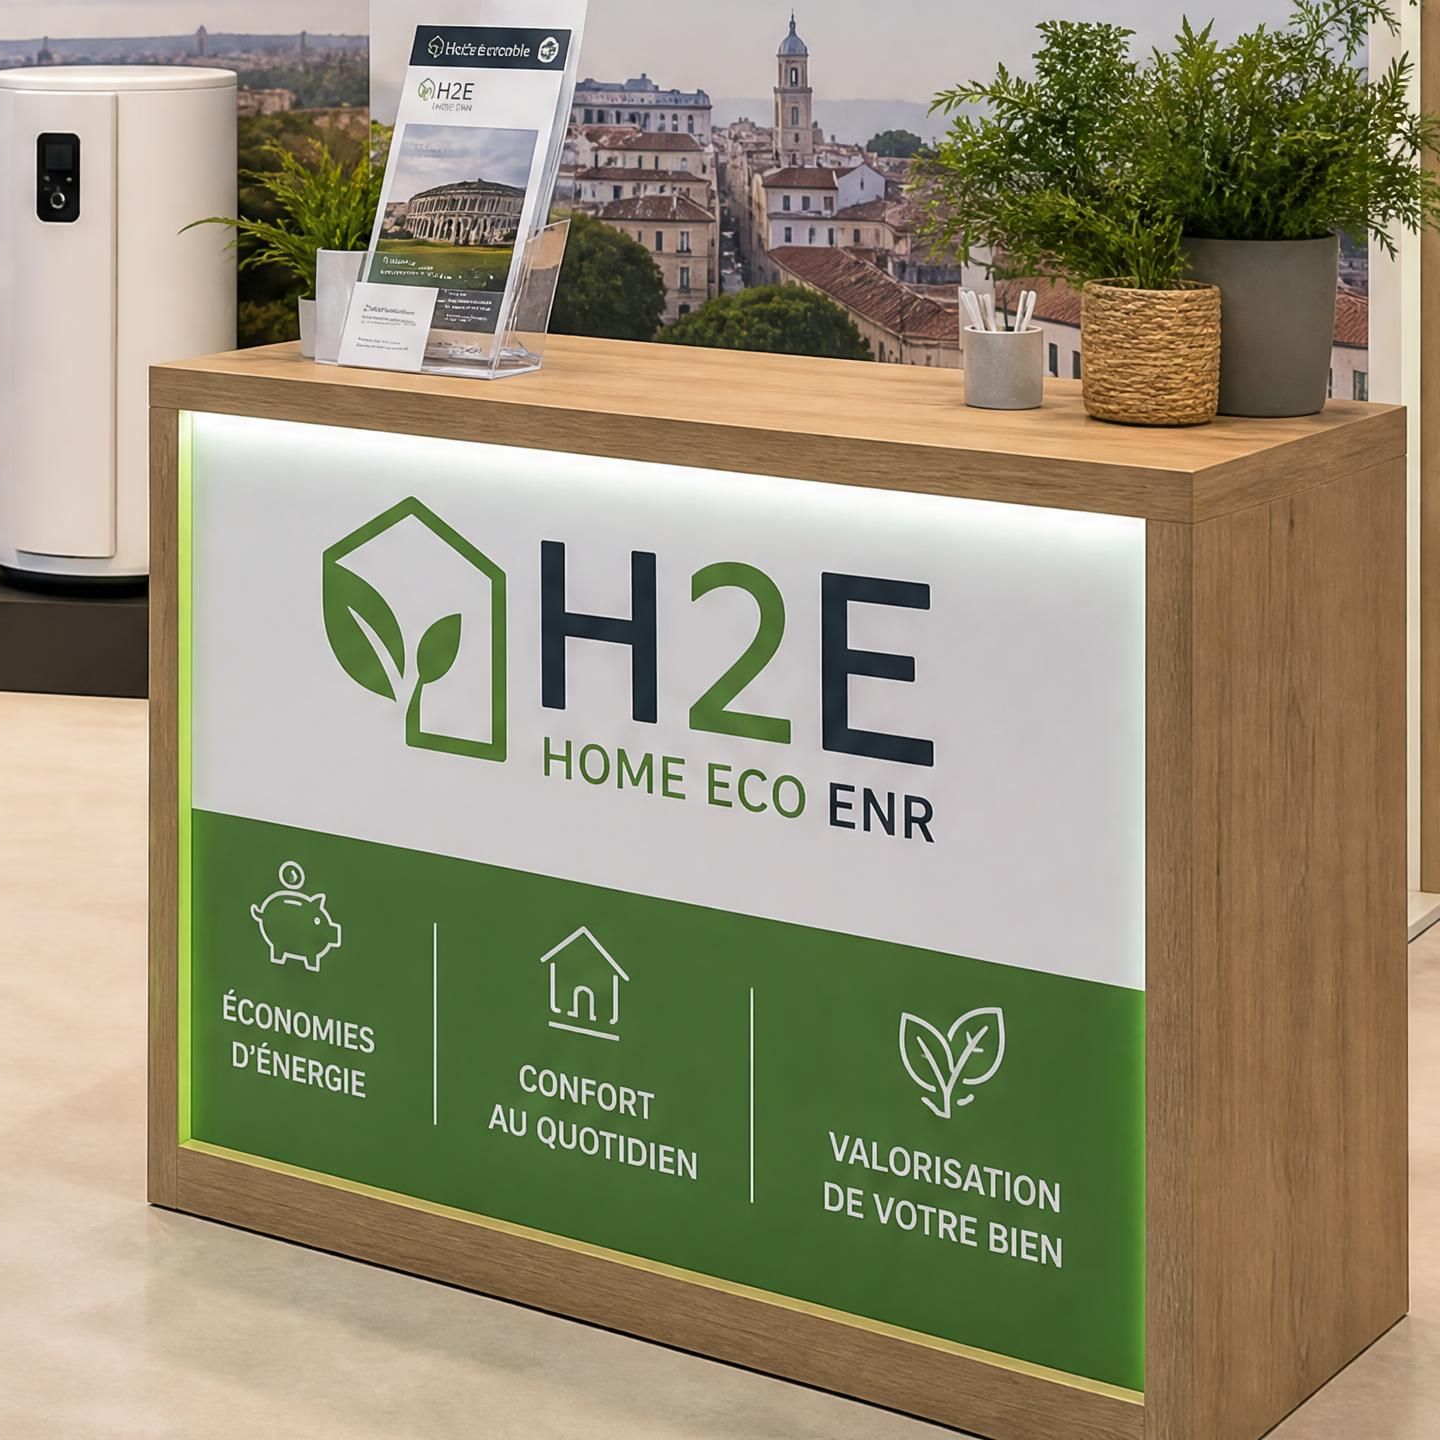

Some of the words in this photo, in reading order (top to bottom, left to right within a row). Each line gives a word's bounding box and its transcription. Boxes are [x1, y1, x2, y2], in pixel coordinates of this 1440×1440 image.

[437, 82, 474, 100] H2E
[541, 540, 934, 767] H2E
[544, 737, 685, 799] HOME
[708, 763, 805, 818] ECO
[830, 783, 934, 843] ENR
[222, 990, 375, 1054] ÉCONOMIES
[520, 1065, 654, 1119] CONFORT
[489, 1104, 526, 1136] AU
[536, 1116, 698, 1180] QUOTIDIEN
[828, 1131, 1061, 1213] VALORISATION
[825, 1182, 863, 1218] DE
[873, 1193, 977, 1247] VOTRE
[990, 1222, 1061, 1268] BIEN
